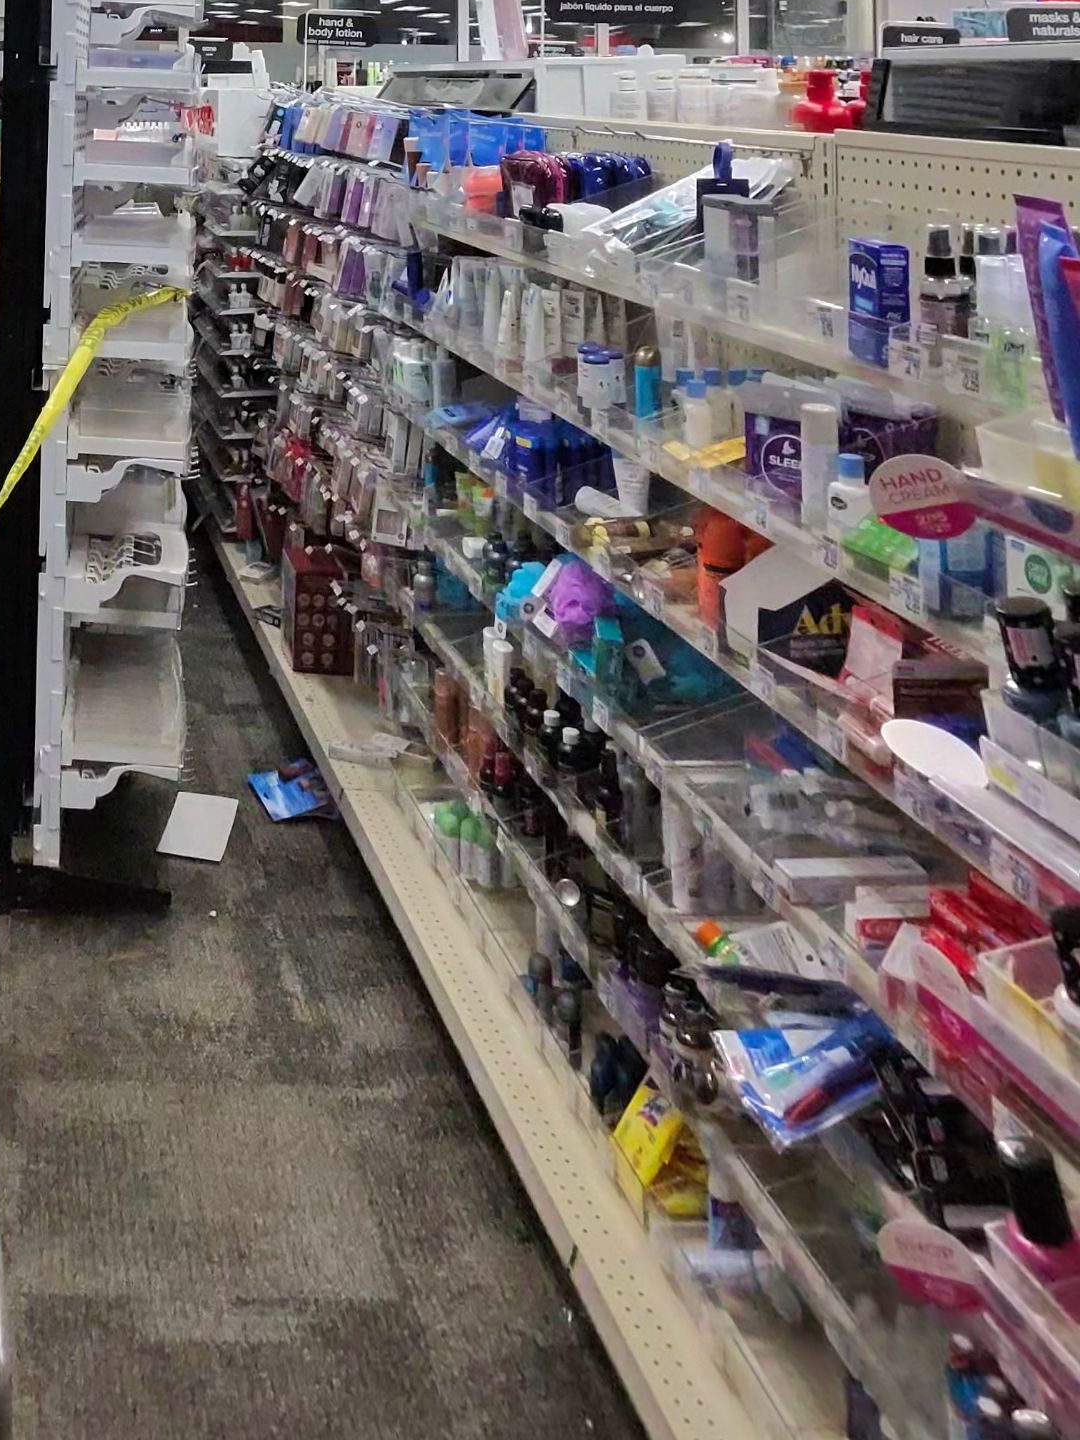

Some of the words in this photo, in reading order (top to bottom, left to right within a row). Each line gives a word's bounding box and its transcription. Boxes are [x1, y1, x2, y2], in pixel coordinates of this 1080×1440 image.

[614, 4, 633, 13] para
[644, 5, 673, 14] cuerpo
[319, 17, 344, 27] hand
[345, 18, 354, 28] &
[1029, 13, 1069, 23] masks
[308, 26, 334, 39] body
[336, 28, 363, 38] lotion
[900, 33, 920, 43] hair
[921, 35, 944, 44] care
[879, 468, 943, 490] HAND
[888, 484, 950, 505] CREAM
